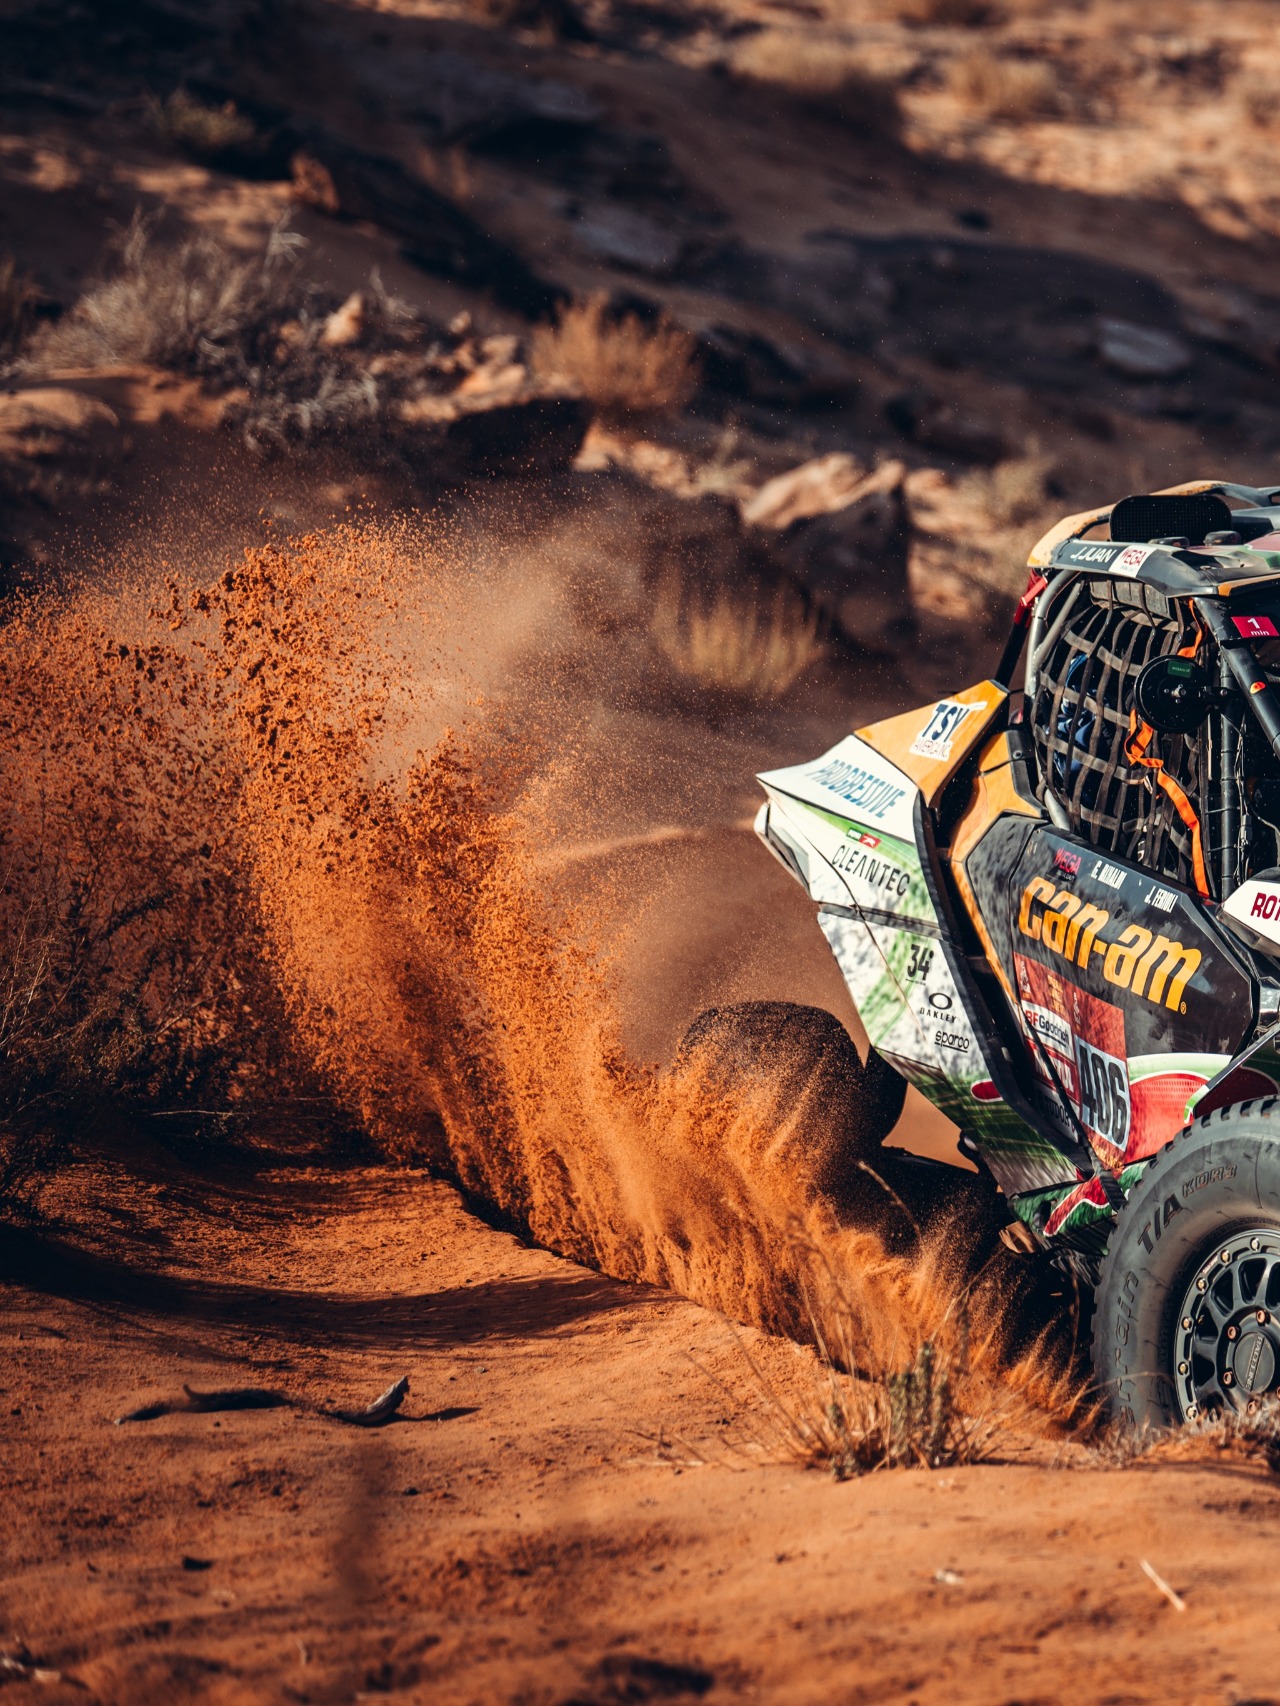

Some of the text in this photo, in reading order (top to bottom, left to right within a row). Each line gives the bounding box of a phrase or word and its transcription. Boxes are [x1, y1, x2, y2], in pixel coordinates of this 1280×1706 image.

[1247, 618, 1261, 629] 1
[922, 703, 970, 743] TSY
[831, 844, 911, 897] CLEANTEC
[1018, 875, 1202, 1013] can-am
[919, 1006, 957, 1024] OAKLEY
[935, 1029, 970, 1052] sparco
[1077, 1044, 1128, 1146] 406
